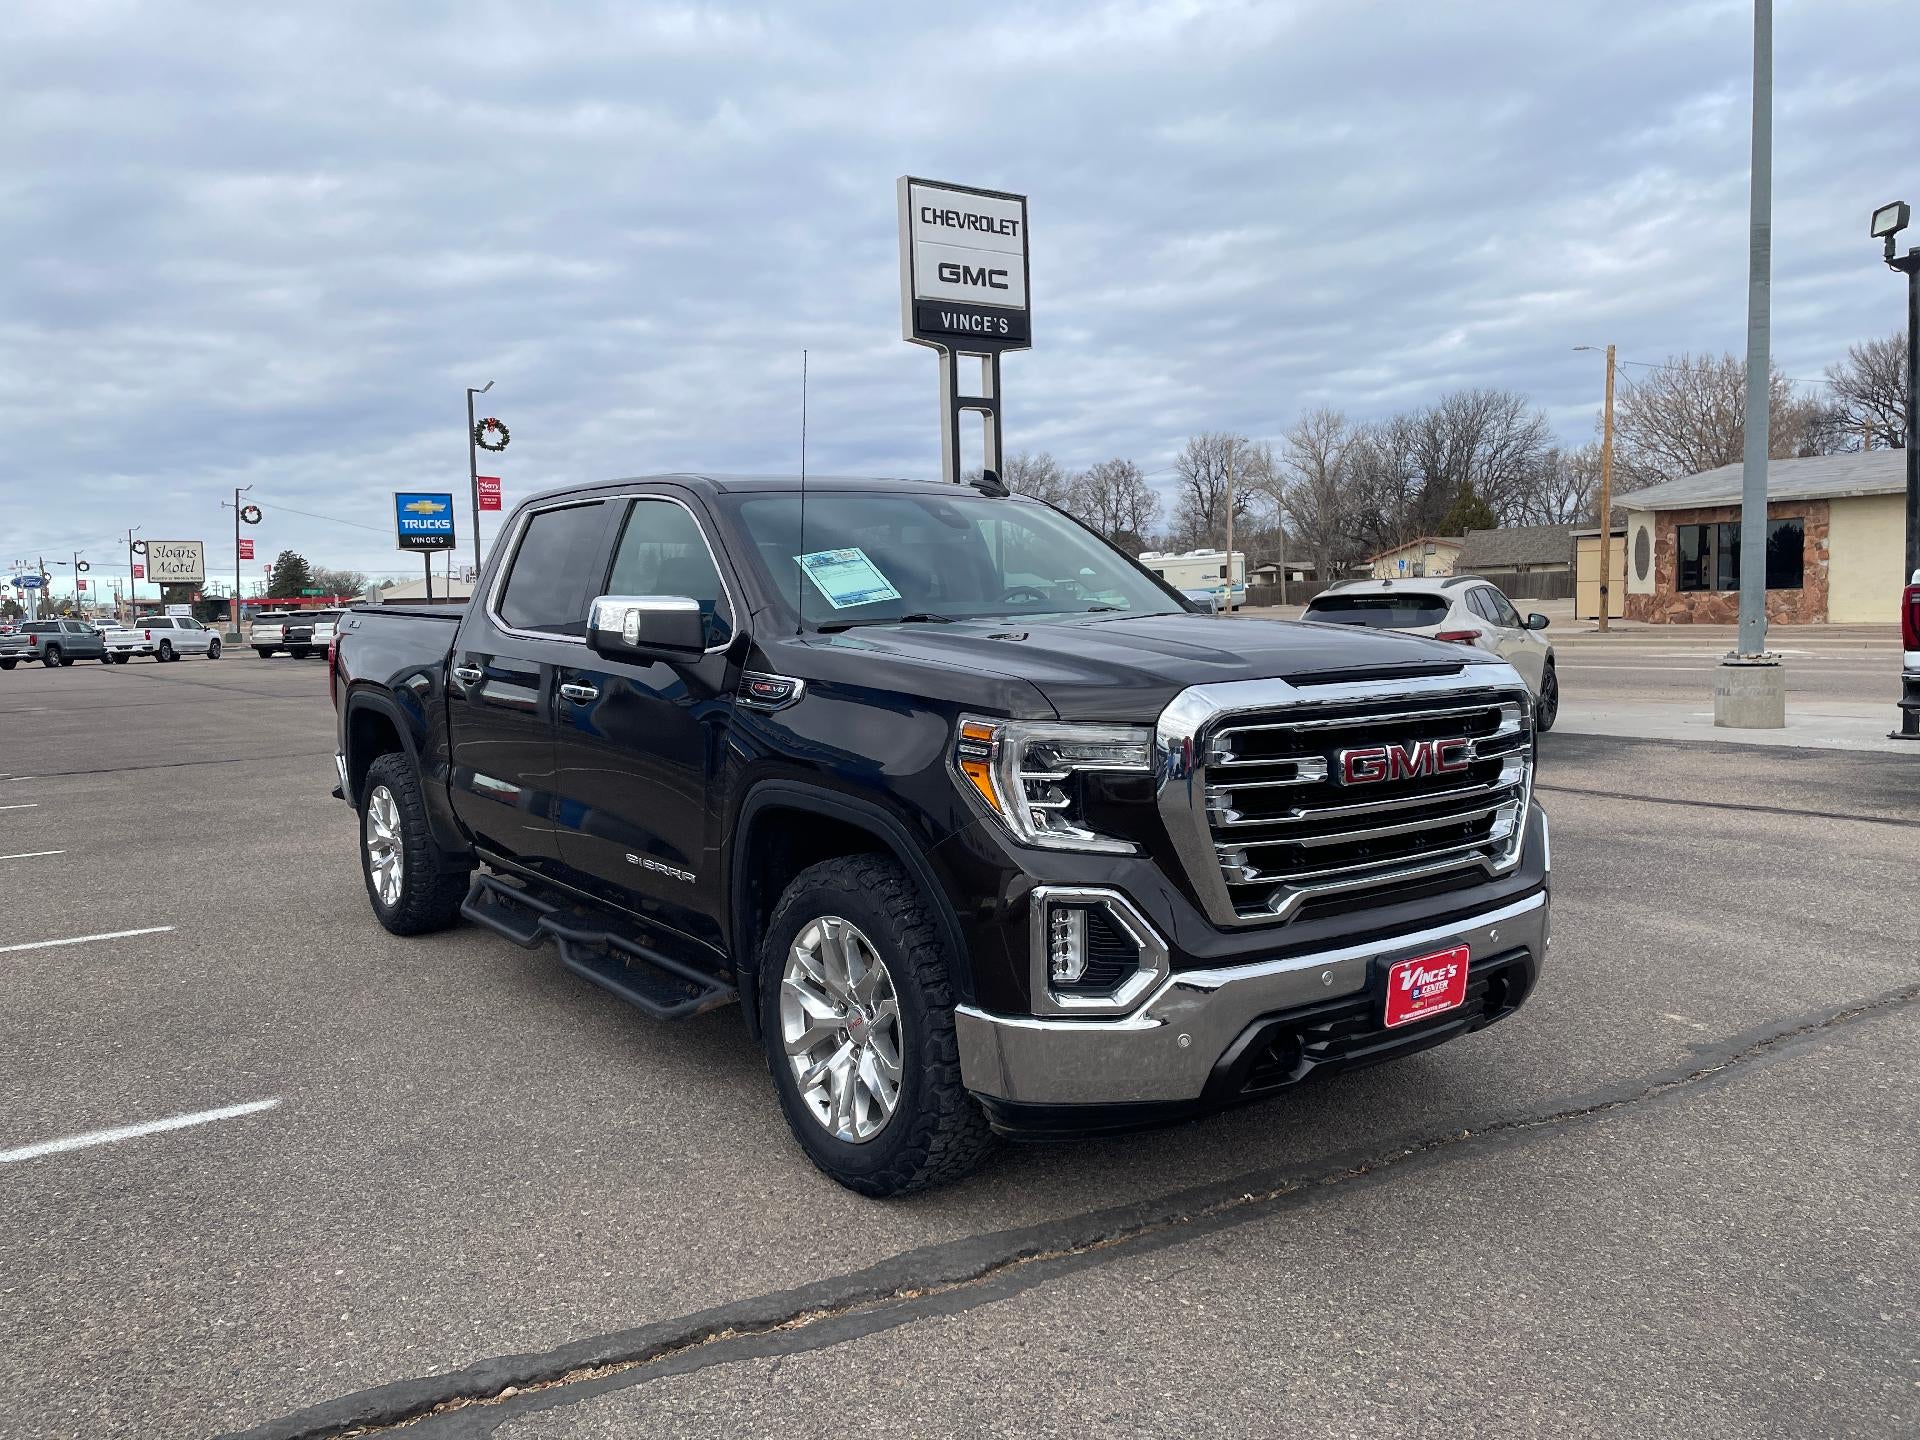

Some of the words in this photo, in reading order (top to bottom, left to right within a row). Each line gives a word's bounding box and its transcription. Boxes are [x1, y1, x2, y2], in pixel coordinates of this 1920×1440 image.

[921, 206, 1019, 237] CHEVROLET
[938, 262, 1008, 289] GMC
[941, 311, 1009, 334] VINCE'S
[402, 519, 450, 529] TRUCKS
[153, 545, 197, 558] Sloans
[410, 536, 444, 544] VINCE'S
[157, 560, 195, 573] Motel
[1340, 738, 1468, 786] GMC
[625, 853, 696, 883] SIERRA
[1399, 964, 1458, 991] VINCE'S
[1421, 980, 1449, 994] CENTER
